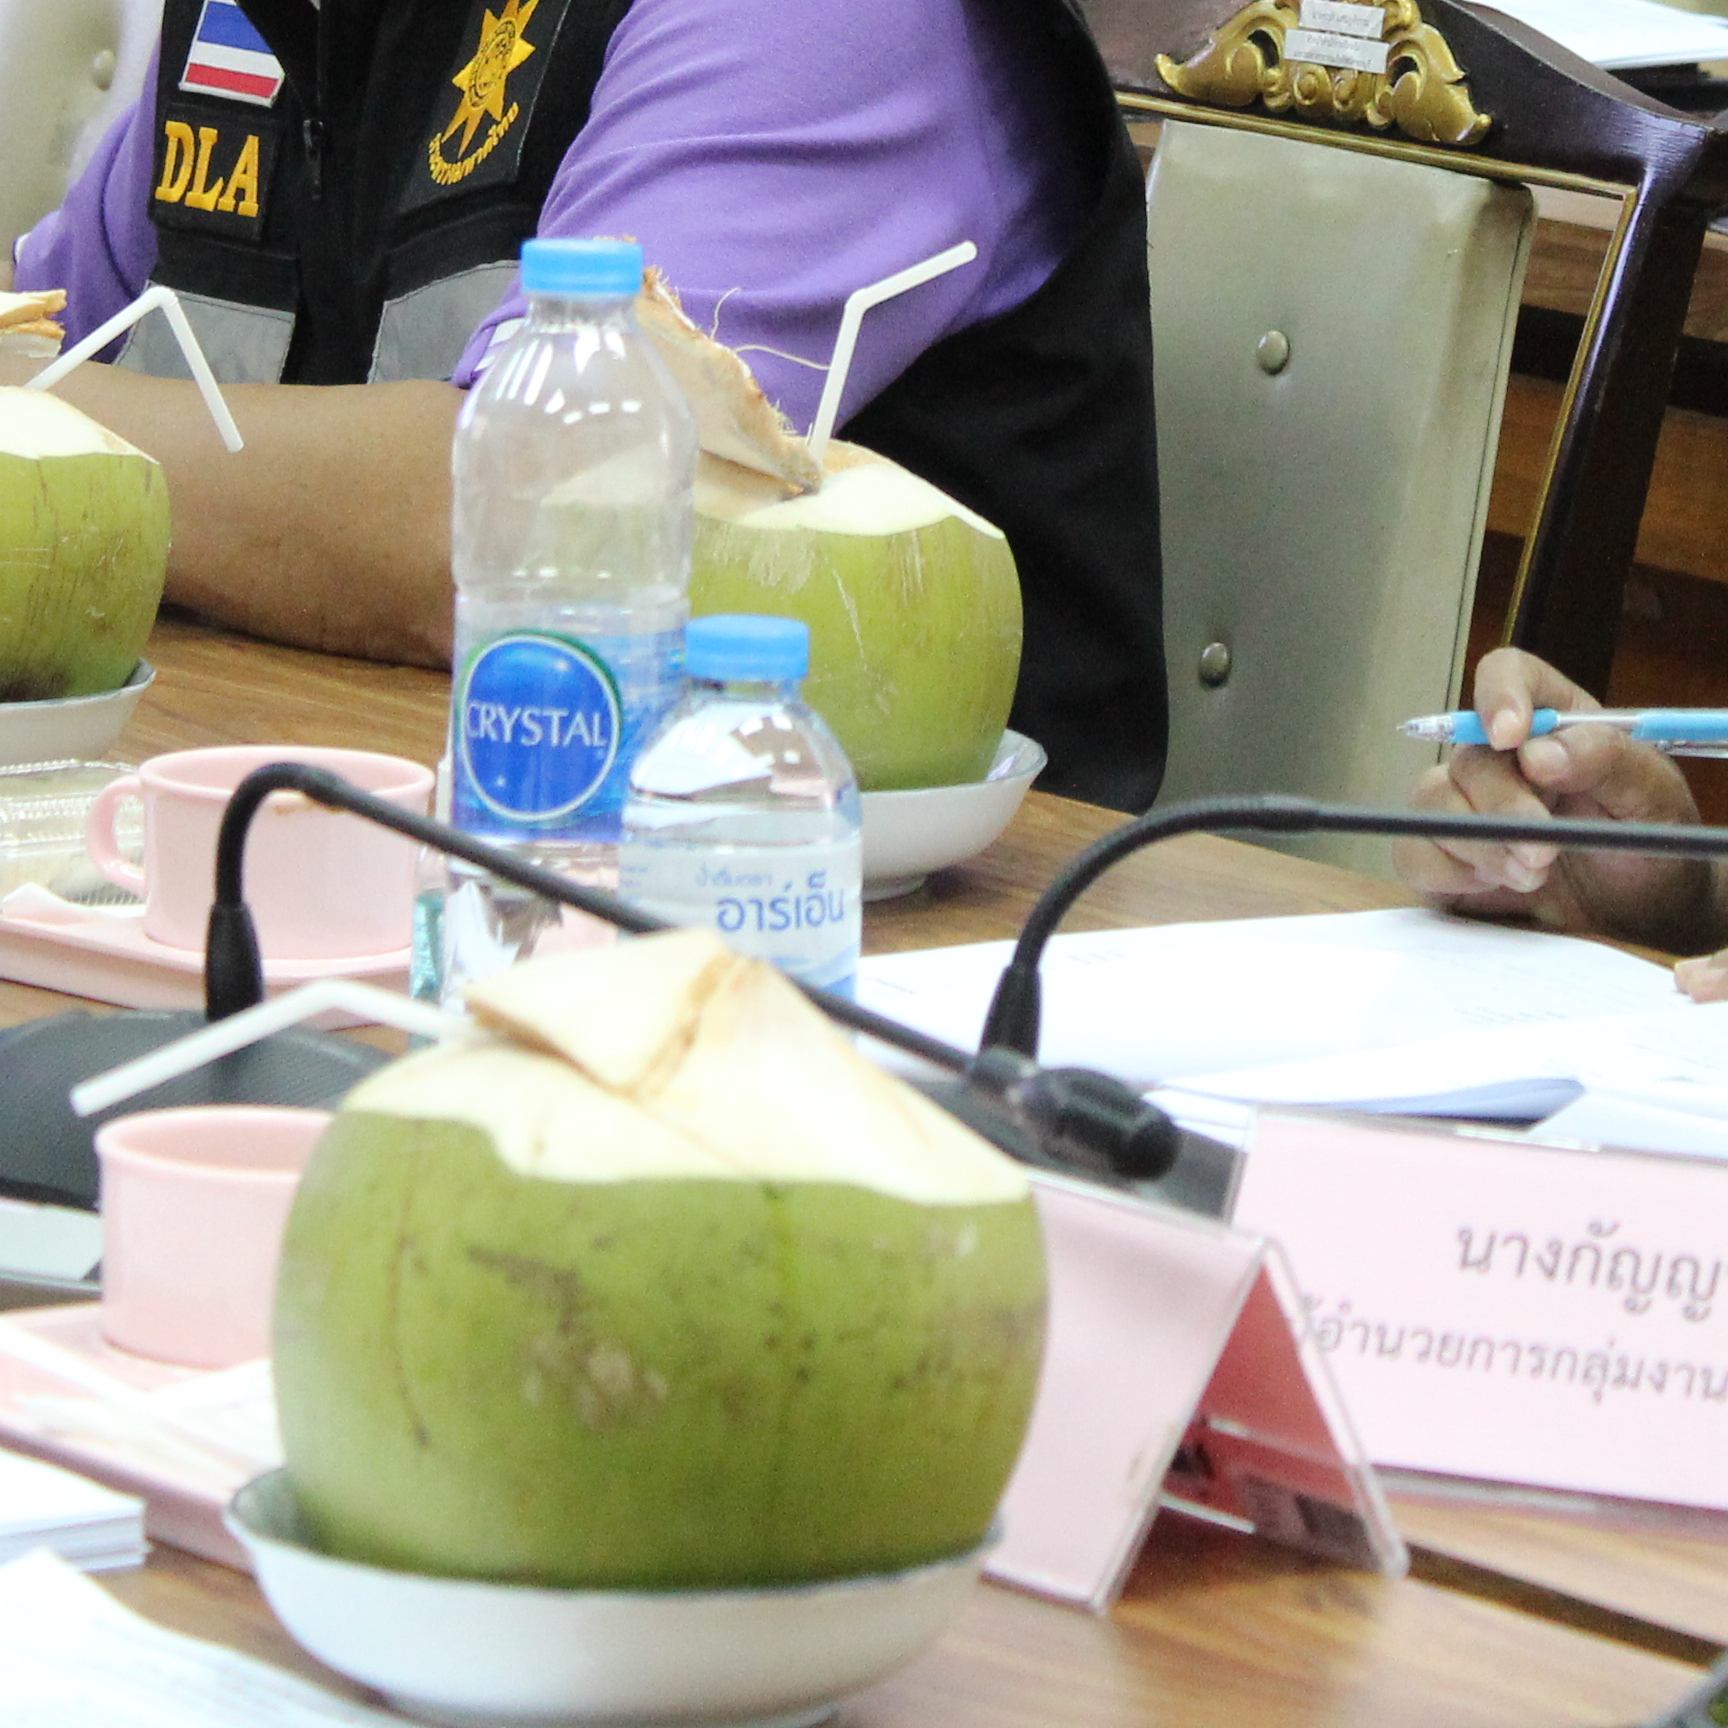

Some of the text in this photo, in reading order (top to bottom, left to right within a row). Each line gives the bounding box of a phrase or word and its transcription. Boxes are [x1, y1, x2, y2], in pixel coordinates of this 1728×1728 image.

[155, 119, 261, 218] DLA
[466, 701, 608, 749] CRYSTAL
[716, 871, 847, 935] อาร์เอ็น
